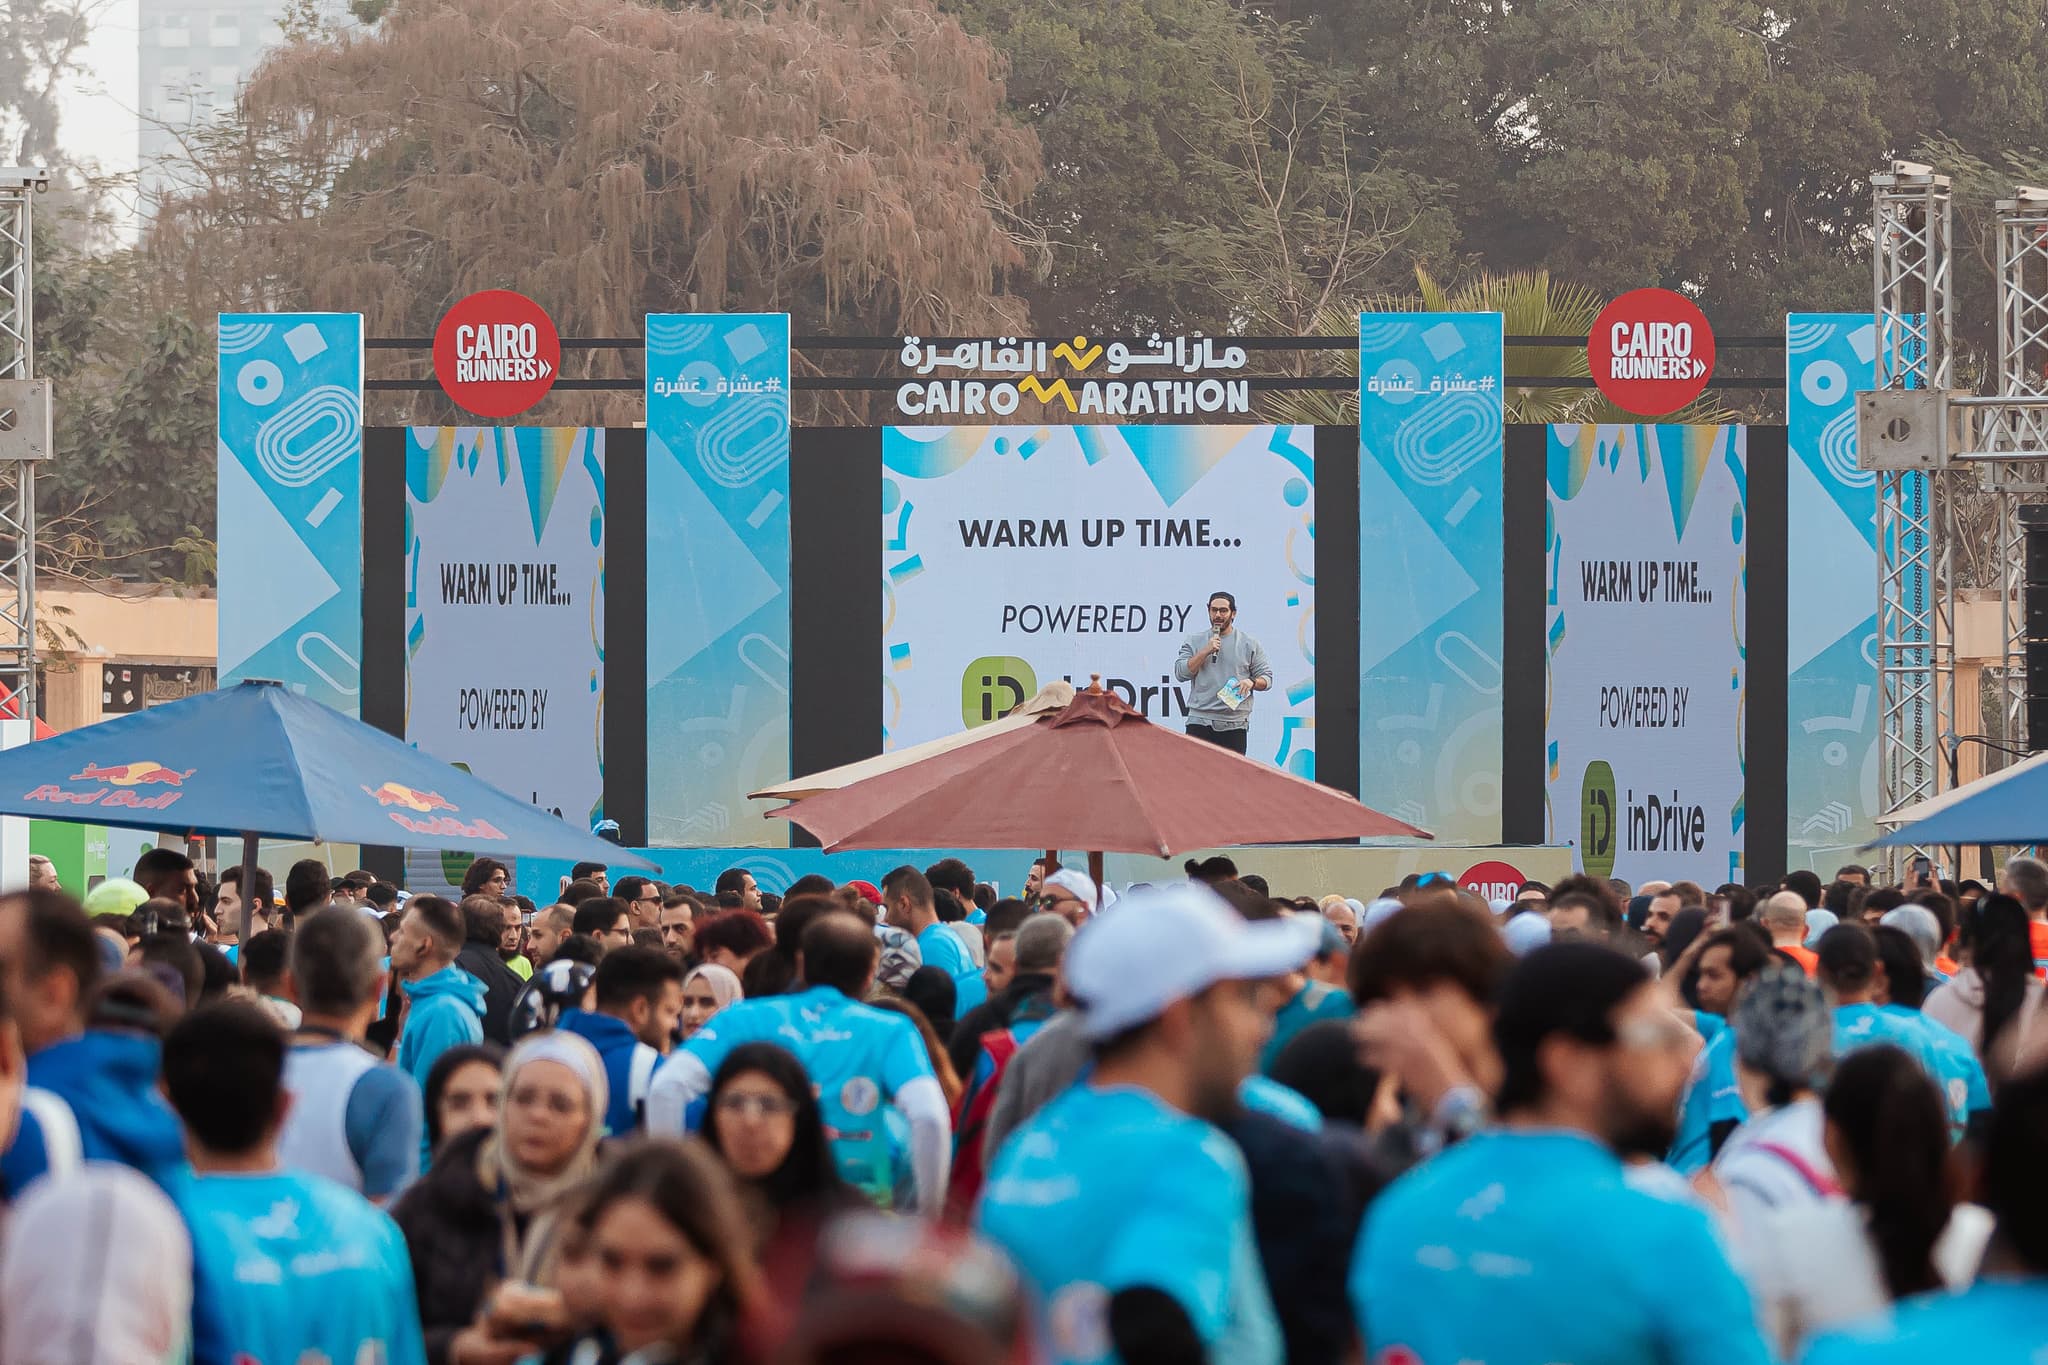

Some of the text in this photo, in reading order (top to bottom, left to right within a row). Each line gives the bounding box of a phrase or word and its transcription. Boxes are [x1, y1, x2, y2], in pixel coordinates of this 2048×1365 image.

[456, 323, 537, 359] CAIRO
[900, 335, 1047, 375] القاهرة
[1611, 322, 1692, 357] CAIRO
[457, 359, 537, 382] RUNNERS
[1611, 357, 1691, 379] RUNNERS
[896, 375, 1249, 416] CAIRO MARATHON
[958, 519, 1242, 547] WARM UP TIME...
[440, 563, 571, 606] WARM UP TIME...
[1581, 560, 1712, 603] WARM UP TIME...
[1001, 604, 1193, 633] POWERED BY
[459, 688, 548, 731] POWERED BY
[1600, 686, 1689, 729] POWERED BY
[24, 784, 183, 810] Red Bull
[1627, 788, 1705, 853] inDrive
